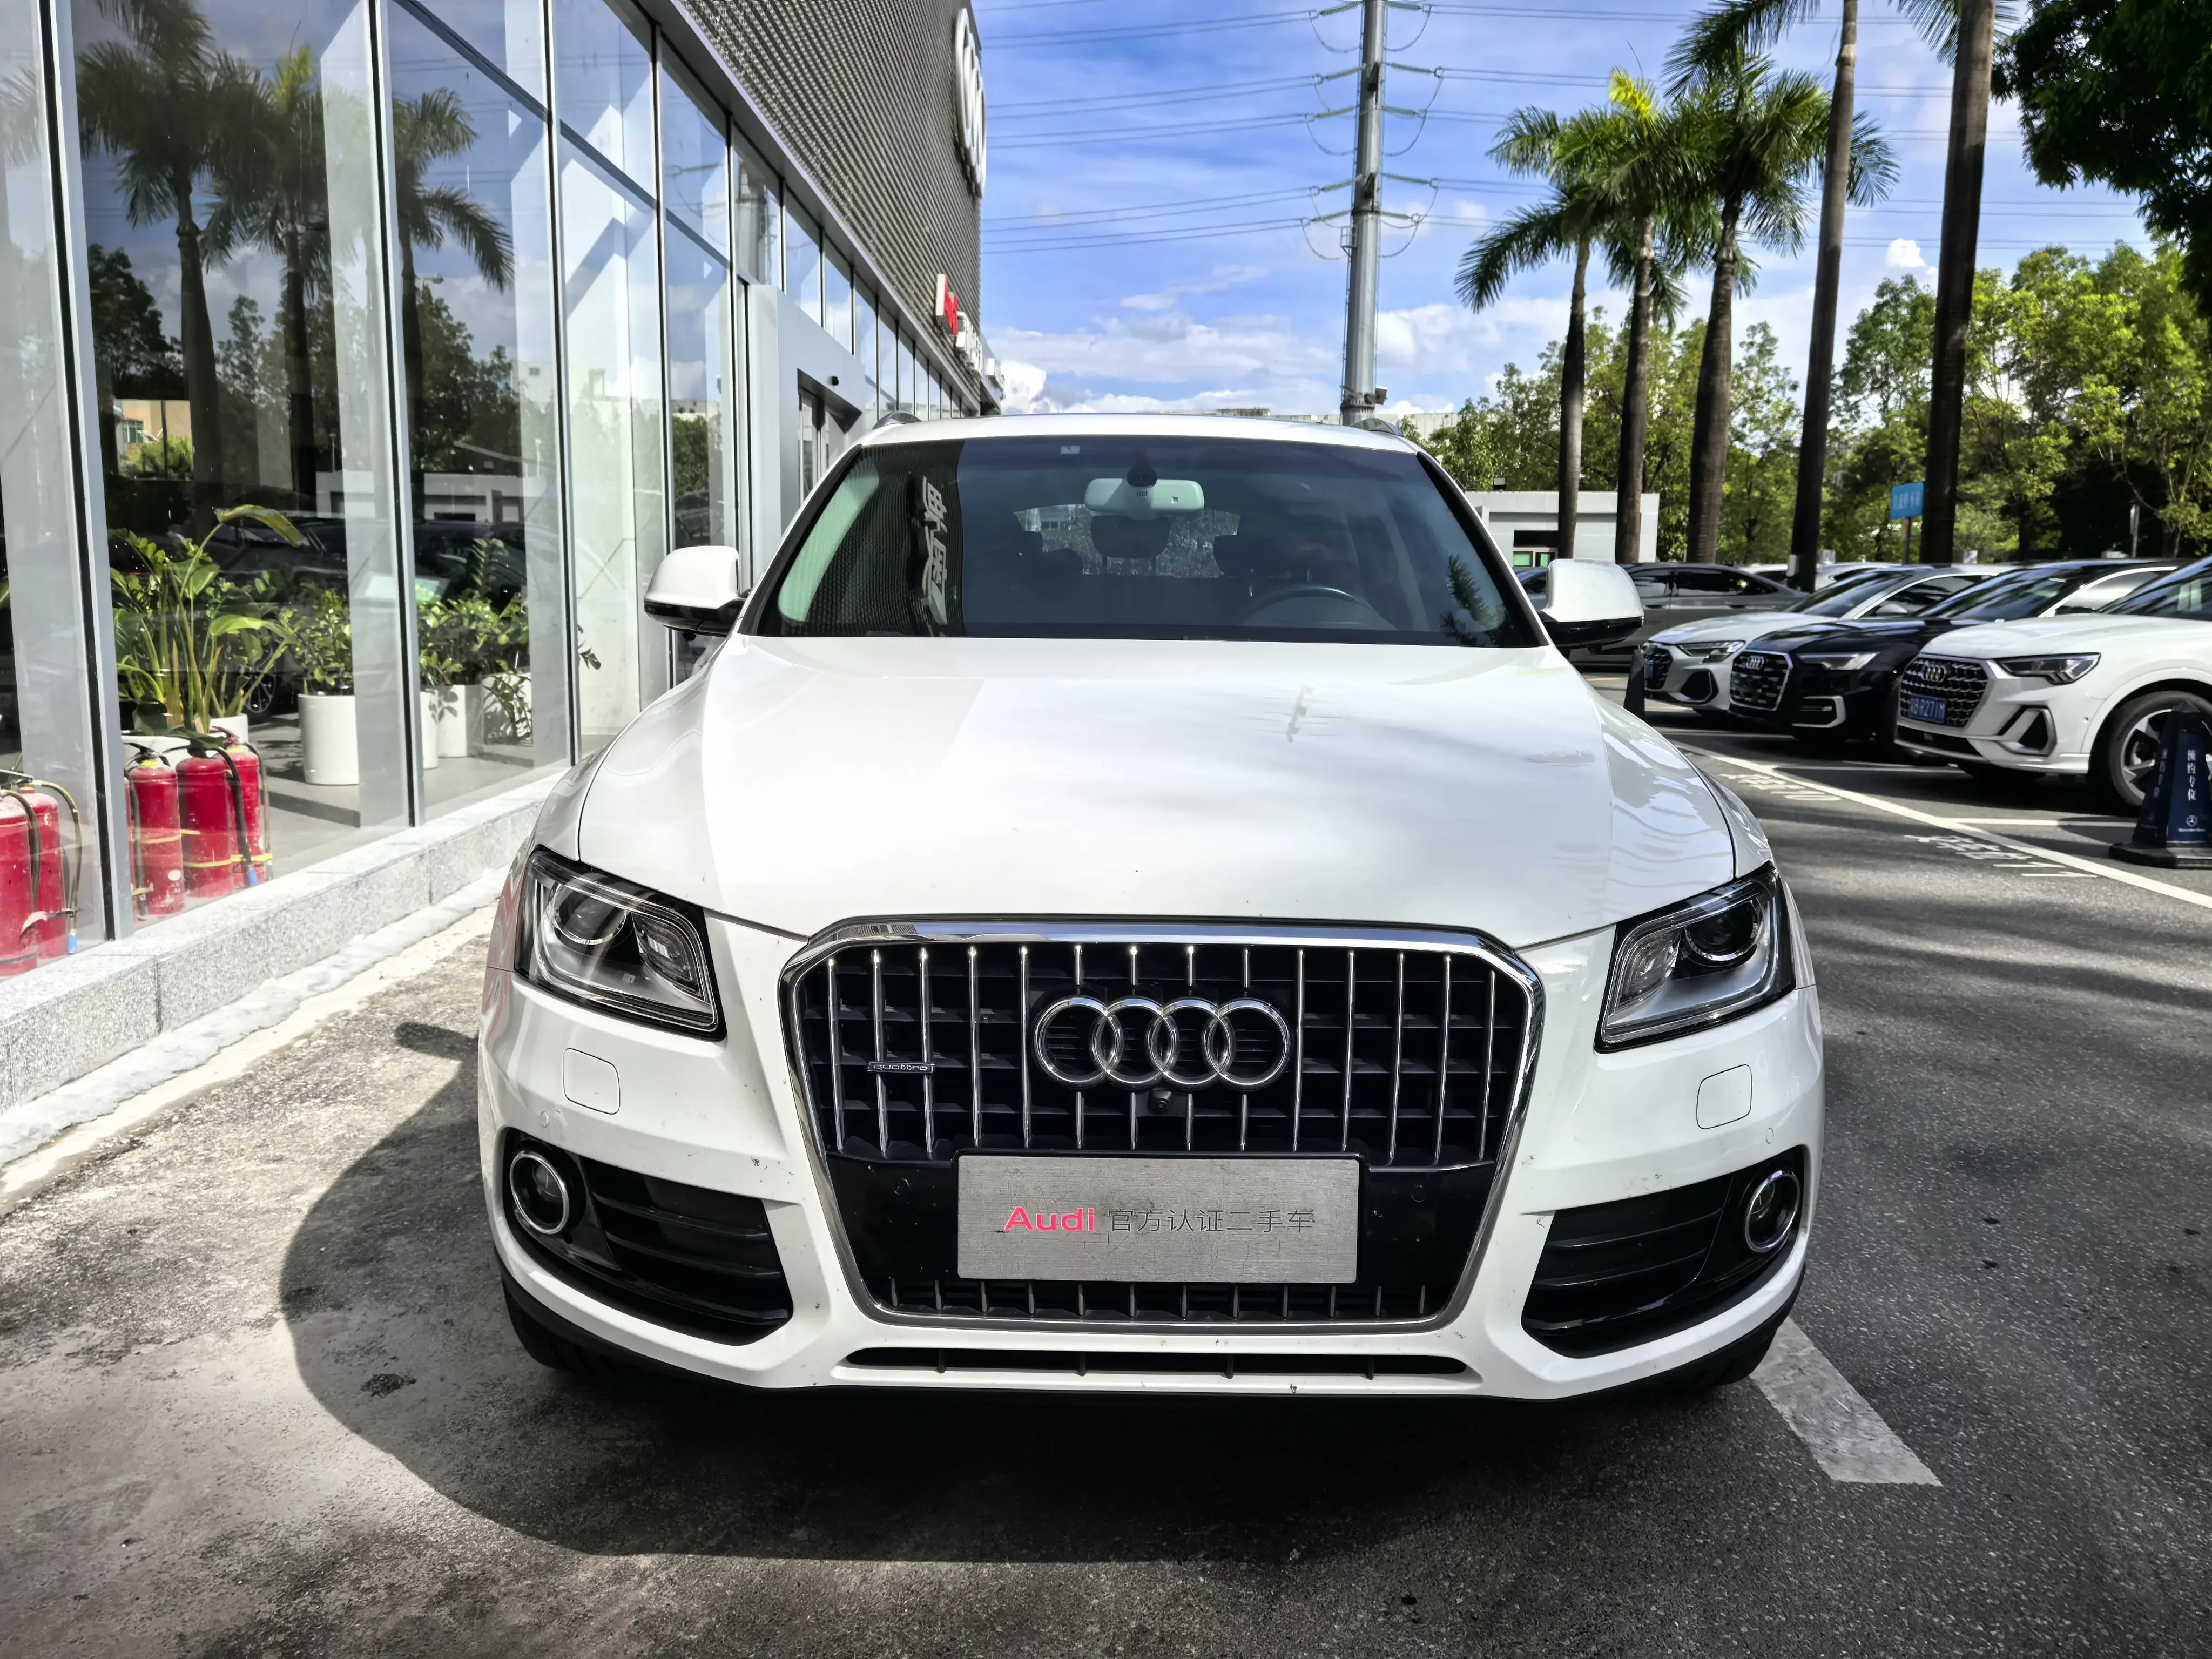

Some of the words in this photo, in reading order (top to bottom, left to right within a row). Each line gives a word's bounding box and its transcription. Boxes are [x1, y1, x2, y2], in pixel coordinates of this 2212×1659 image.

[873, 1063, 928, 1071] quattro
[1004, 1206, 1095, 1232] Audi
[1107, 1208, 1315, 1233] 官方认证二手车
